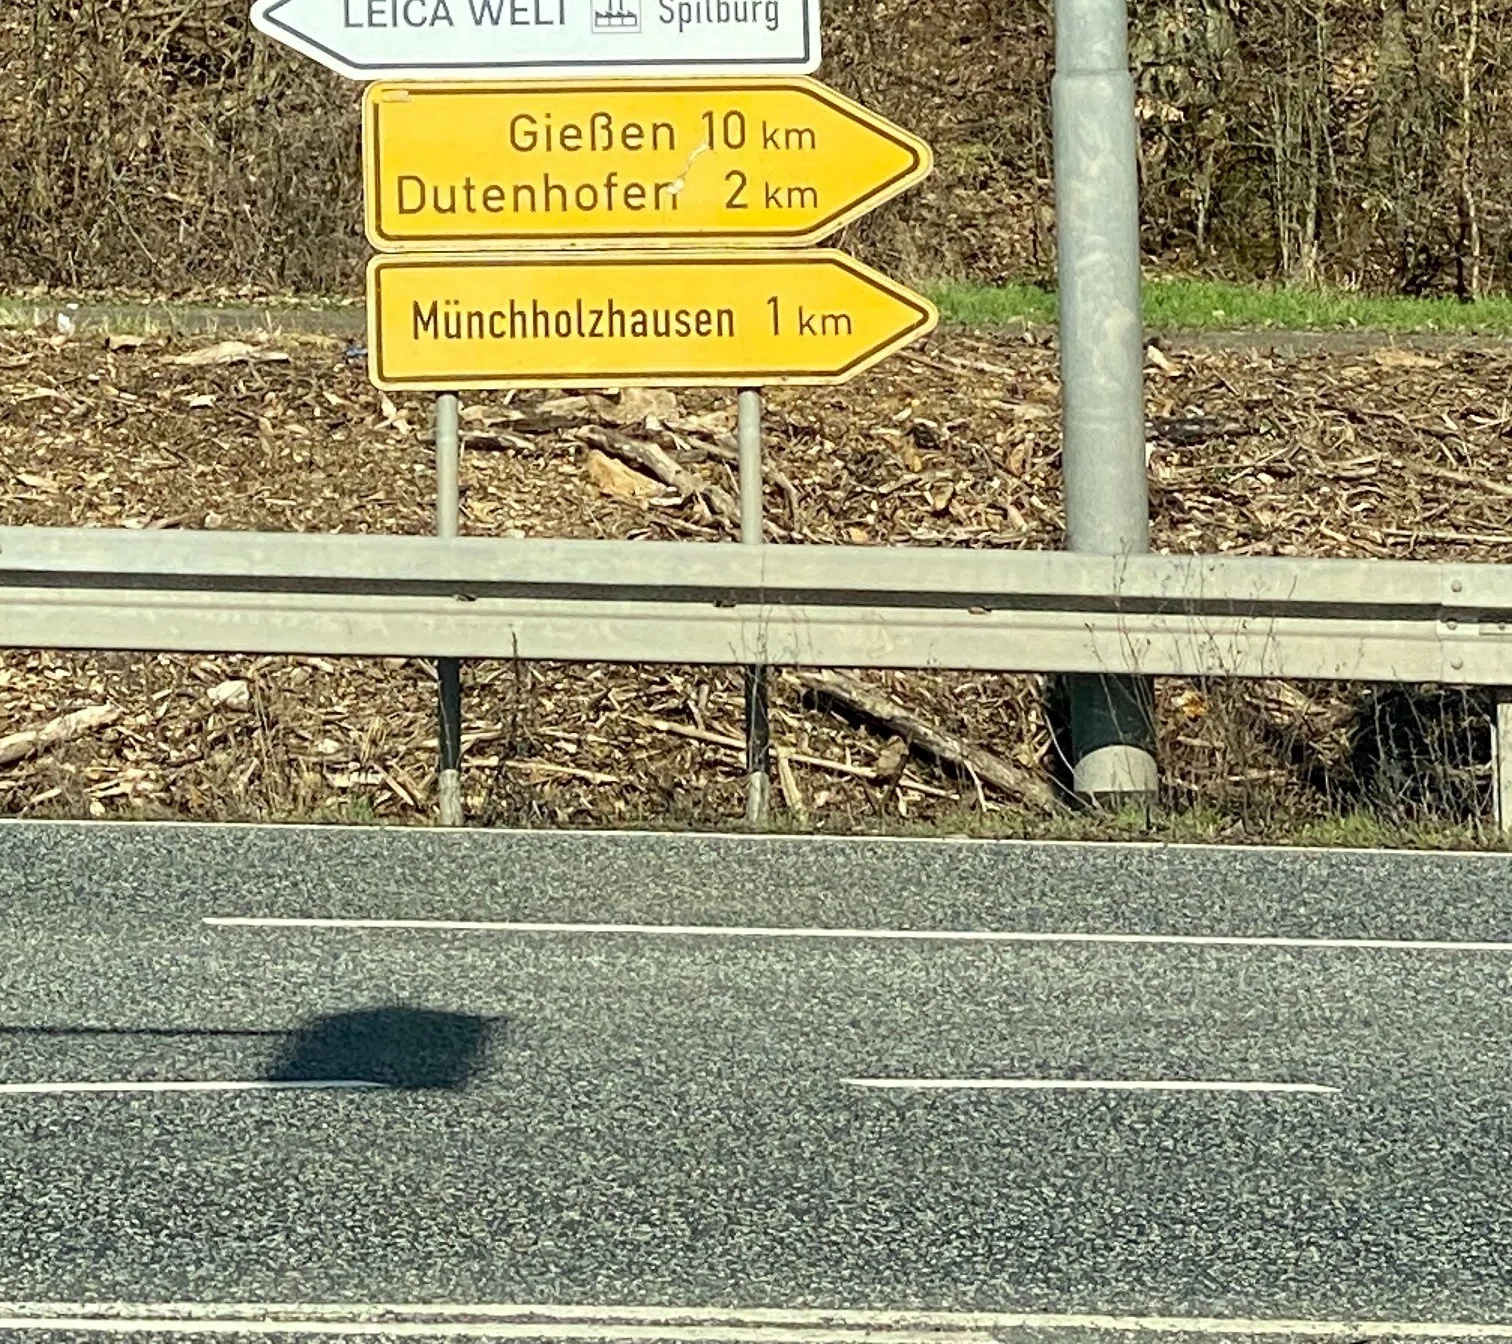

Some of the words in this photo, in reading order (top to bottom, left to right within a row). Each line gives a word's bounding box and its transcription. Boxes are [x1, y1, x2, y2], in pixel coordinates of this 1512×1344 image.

[510, 112, 676, 152] Gießen
[700, 110, 745, 151] 10
[762, 119, 816, 150] km
[397, 173, 679, 215] Dutenhofen
[725, 170, 748, 209] 2
[764, 179, 818, 209] km
[413, 298, 735, 341] Münchholzhausen
[767, 296, 781, 336] 1
[798, 304, 852, 336] km
